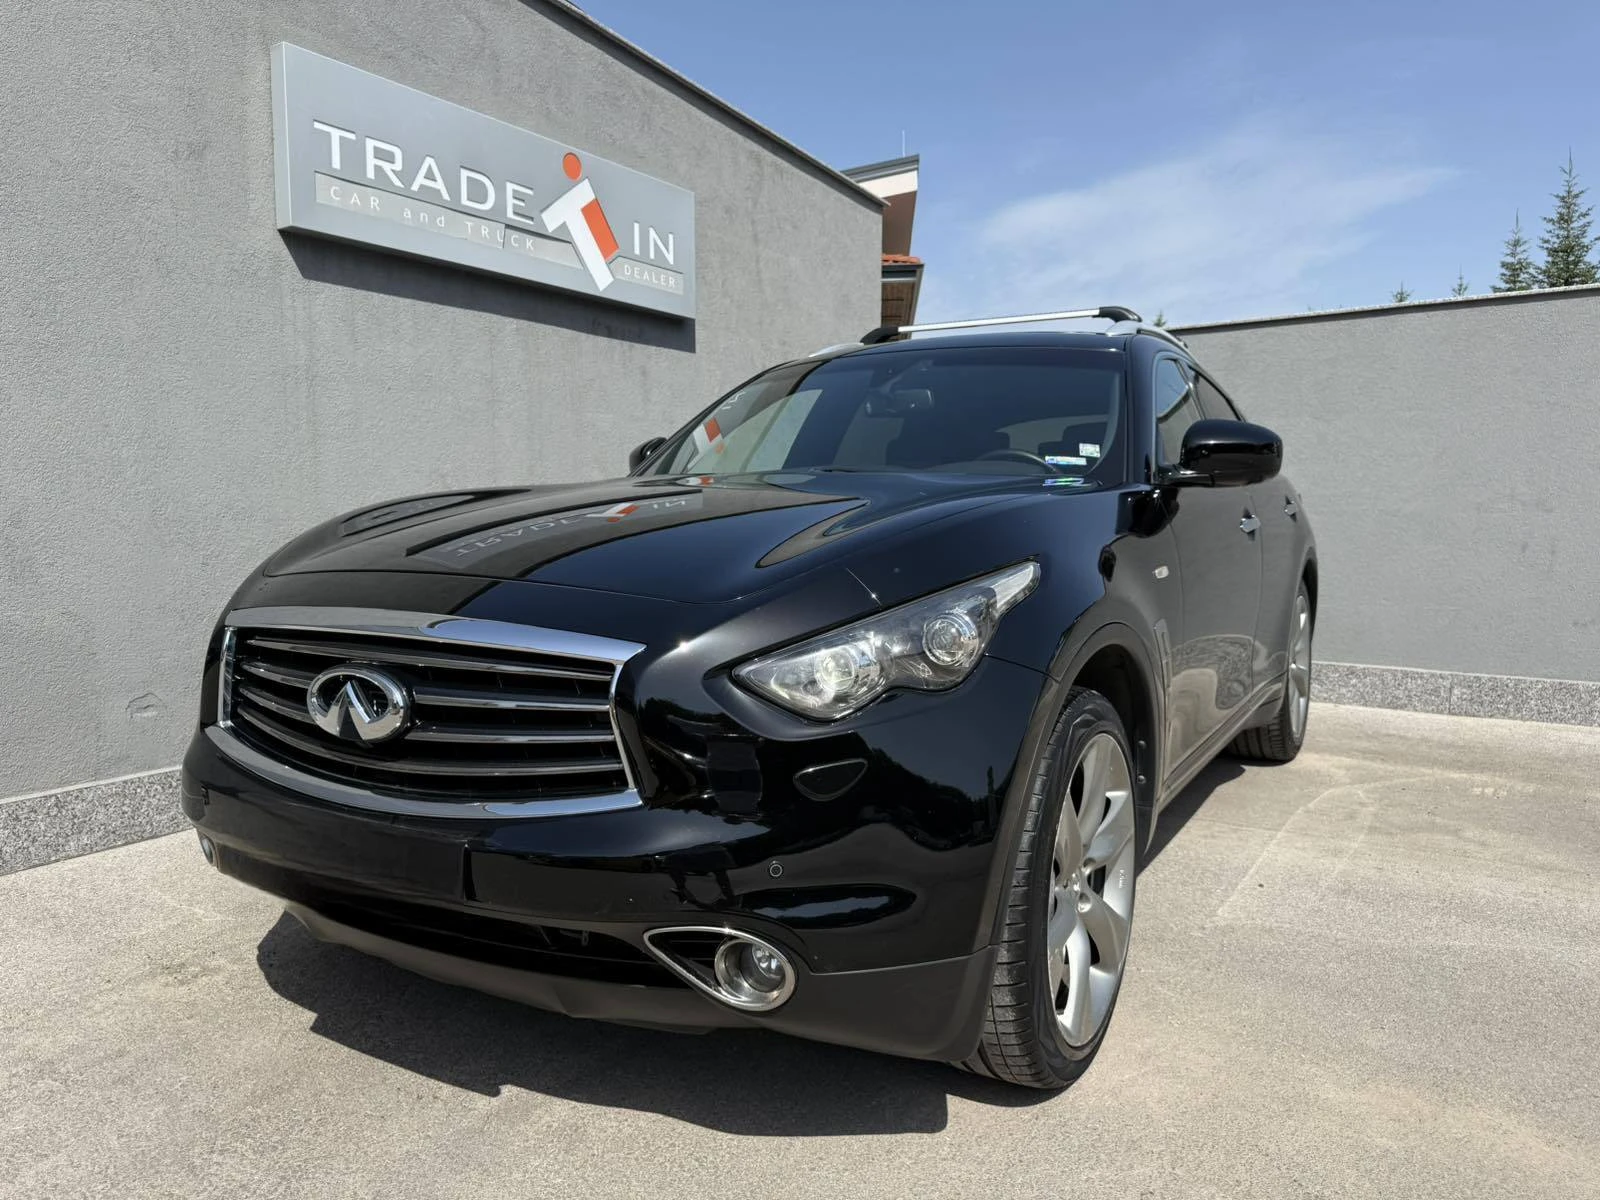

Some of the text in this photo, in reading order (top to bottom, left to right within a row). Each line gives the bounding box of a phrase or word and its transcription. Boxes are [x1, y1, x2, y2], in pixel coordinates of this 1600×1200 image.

[313, 120, 535, 225] TRADE
[633, 221, 674, 265] IN
[330, 186, 535, 251] CAR and TRUCK
[624, 264, 676, 289] DEALER
